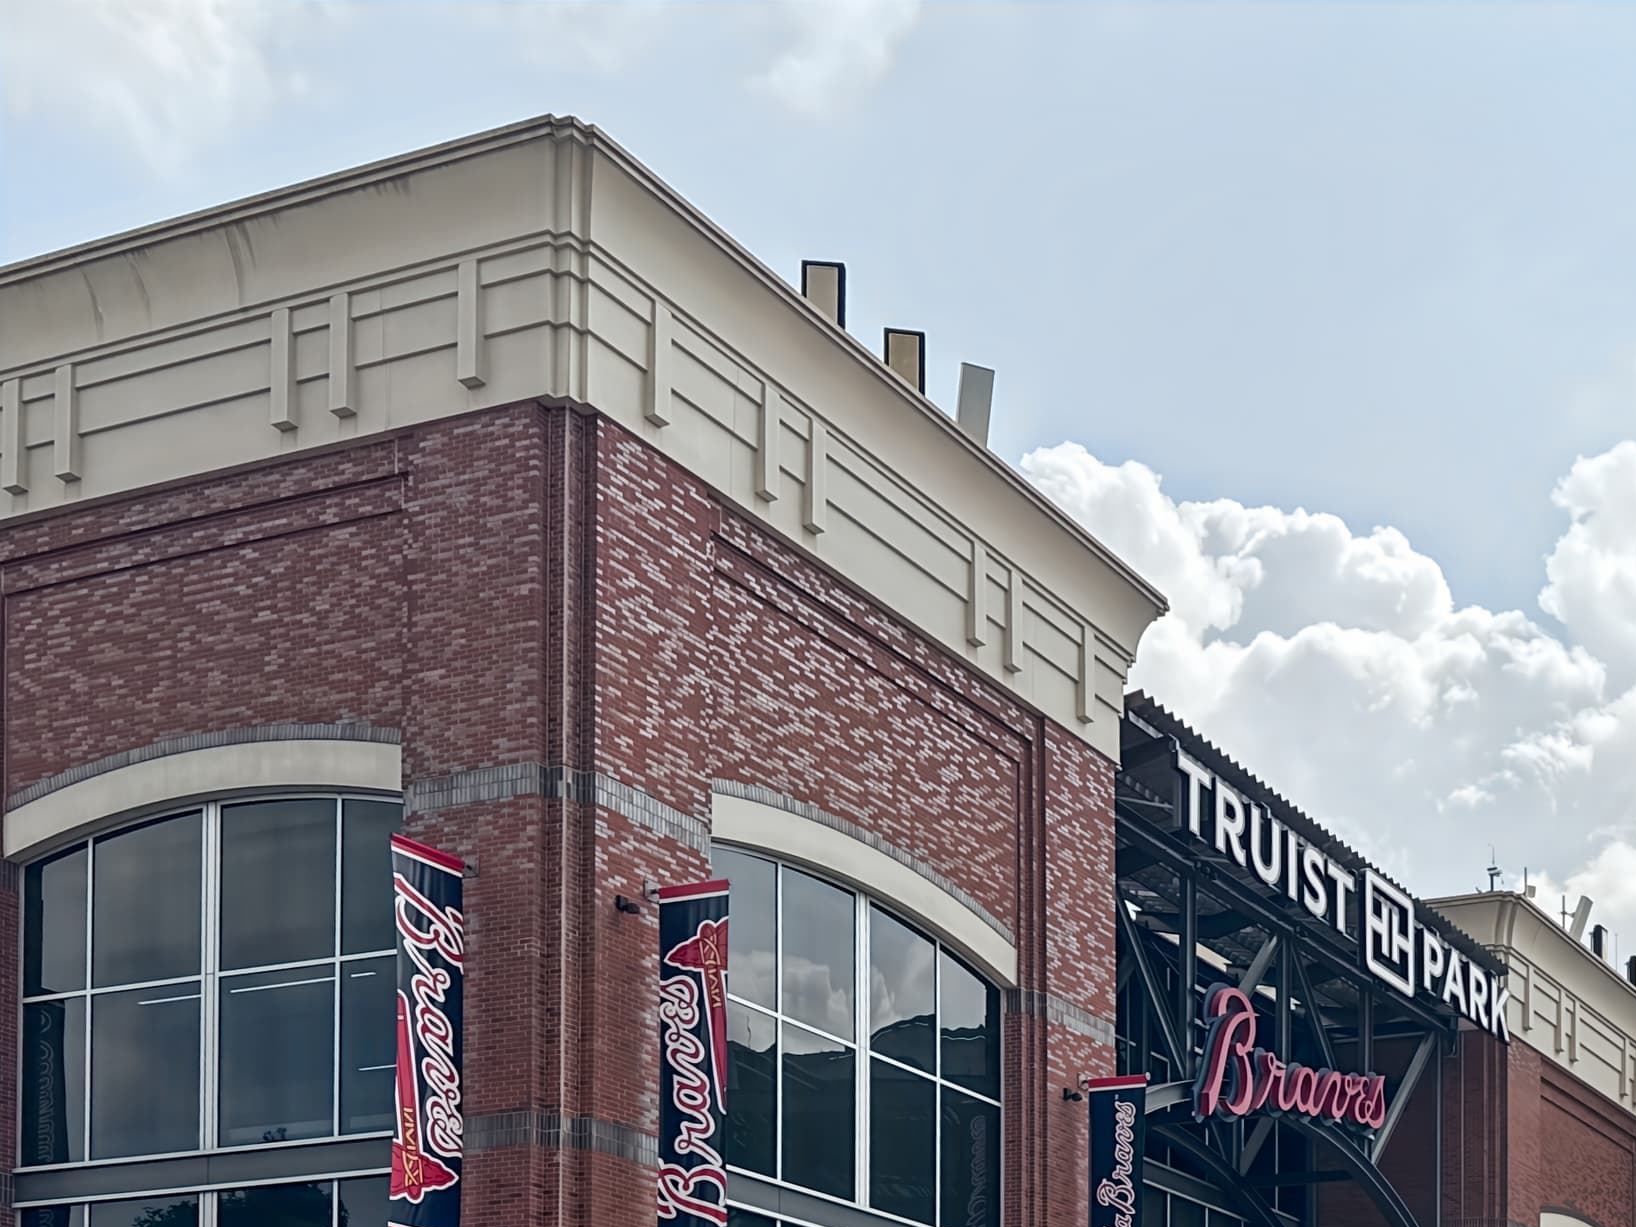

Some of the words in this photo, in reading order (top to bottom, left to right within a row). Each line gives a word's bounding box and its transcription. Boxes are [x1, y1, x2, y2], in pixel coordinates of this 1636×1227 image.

[1178, 750, 1356, 938] TRUIST
[1423, 925, 1512, 1046] PARK
[394, 872, 464, 1160] Braves
[1199, 986, 1387, 1130] Braves
[1096, 1100, 1137, 1215] Braves
